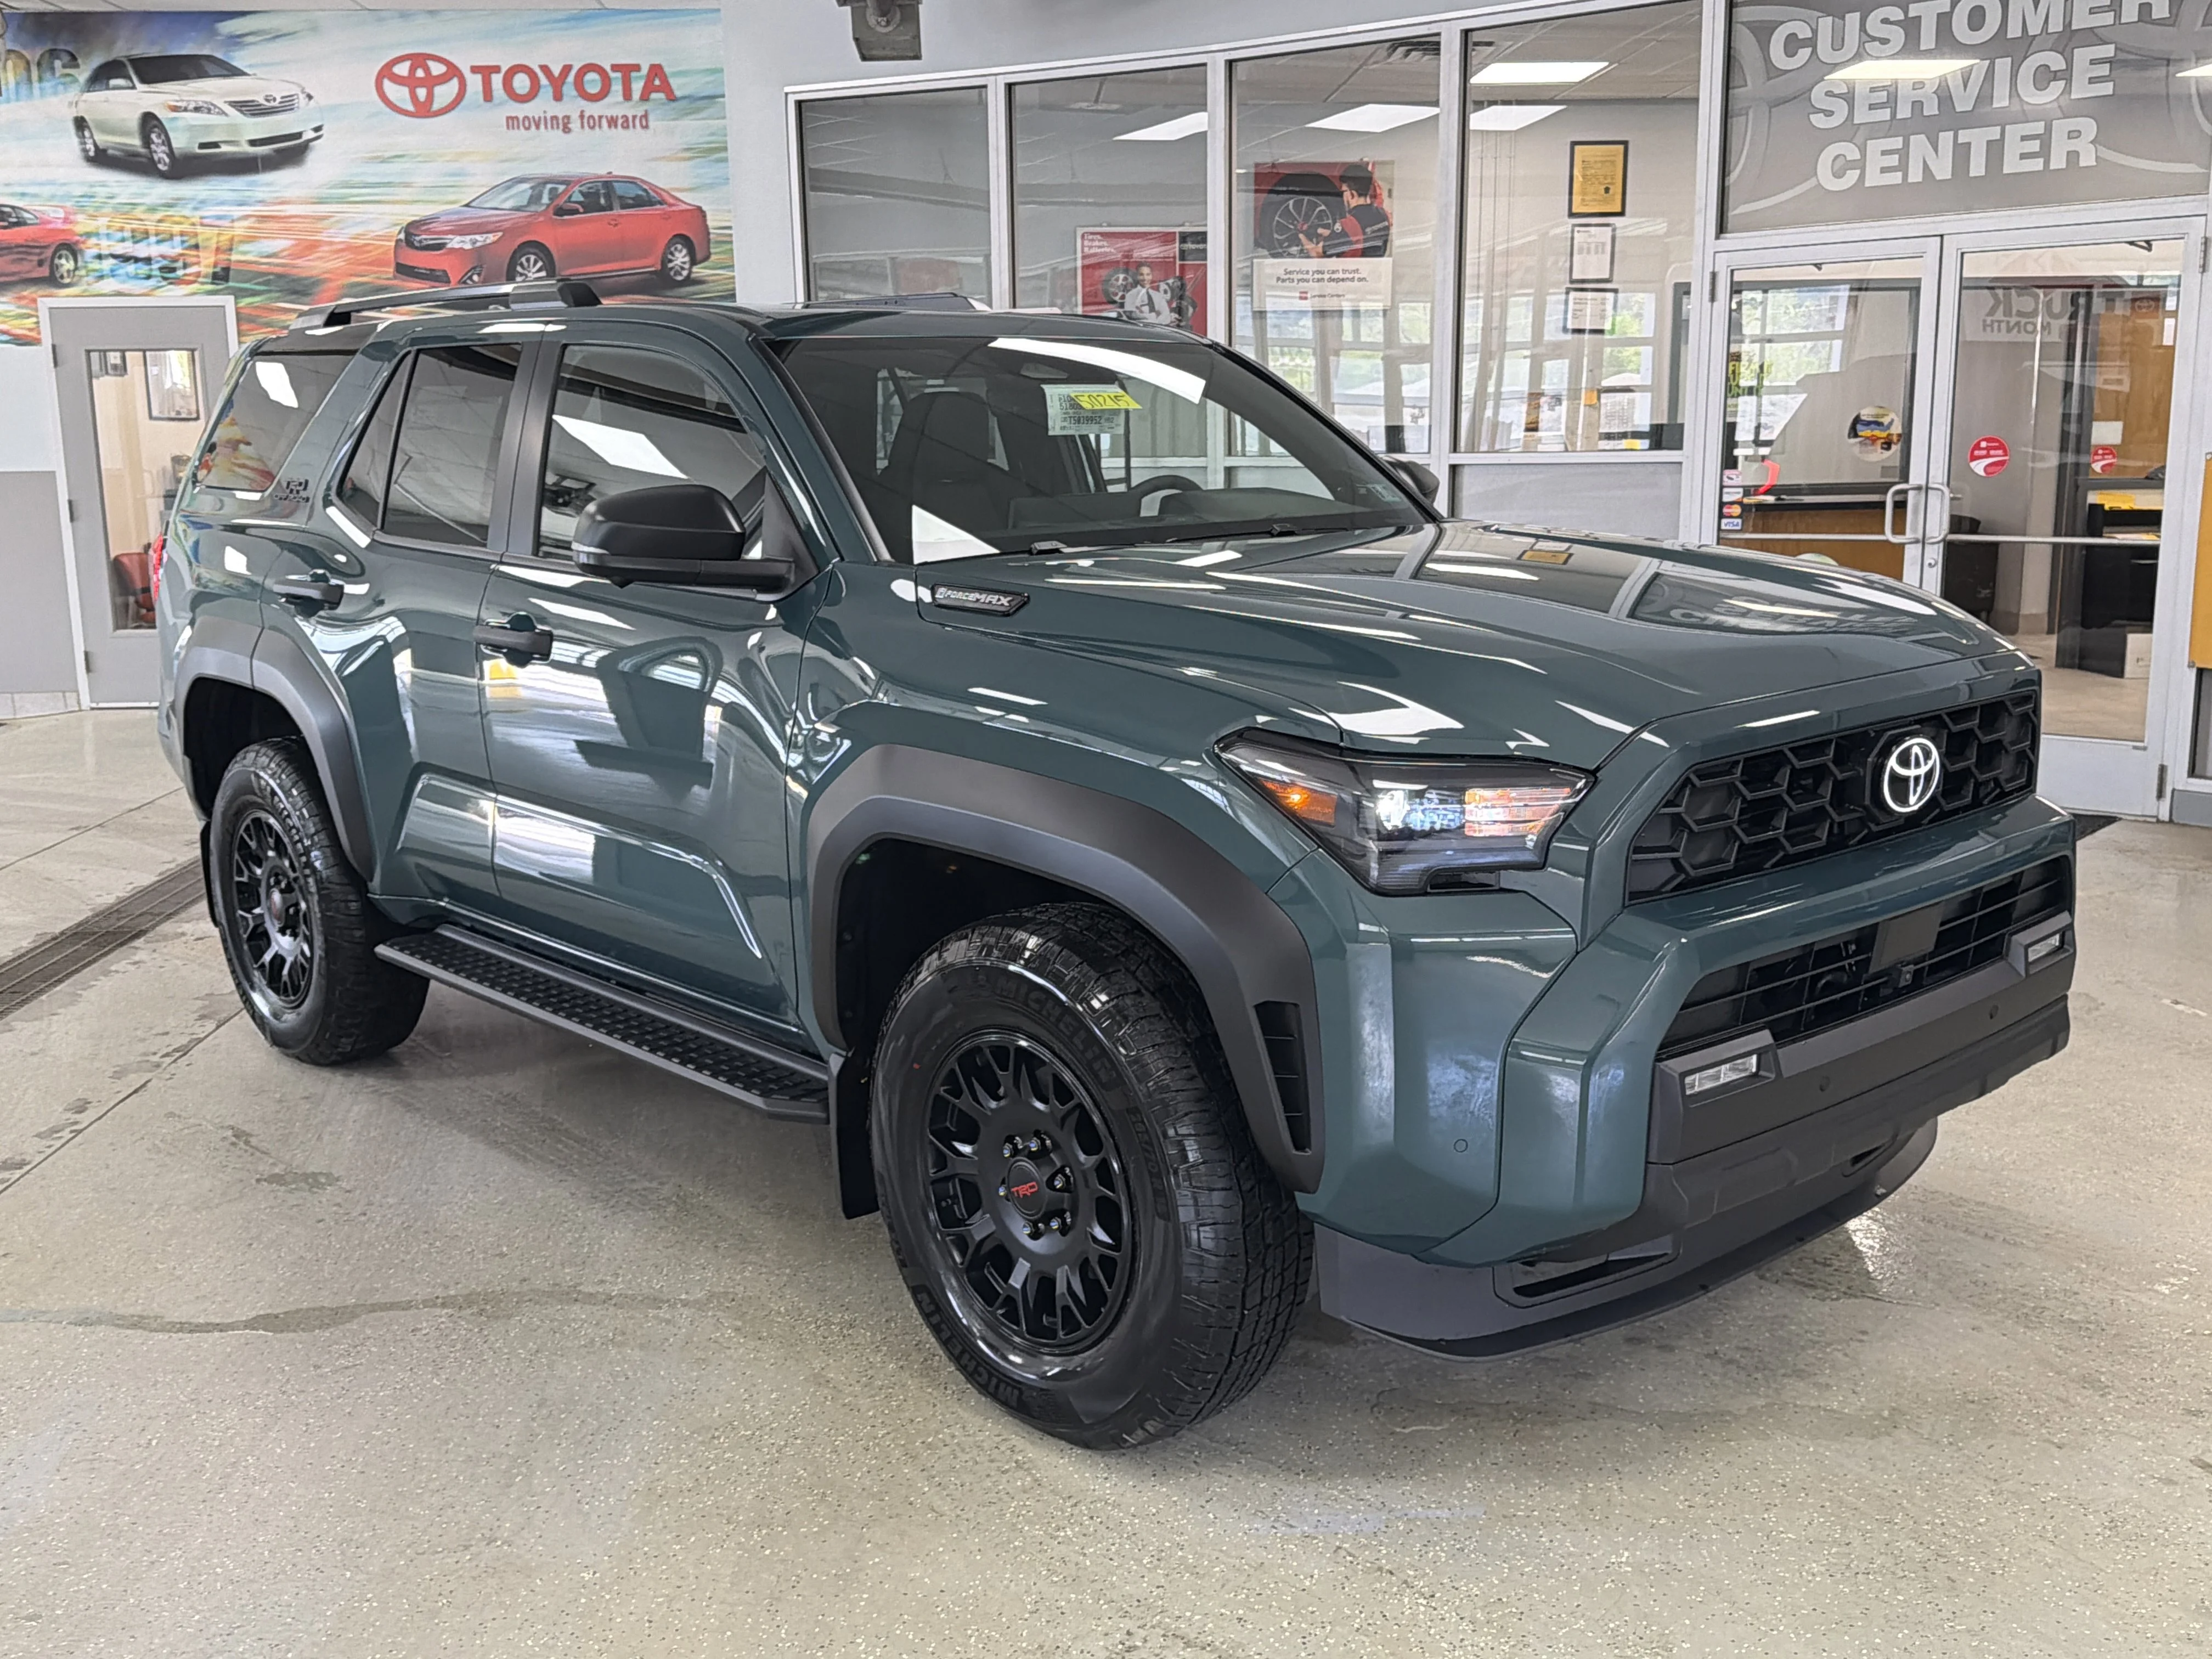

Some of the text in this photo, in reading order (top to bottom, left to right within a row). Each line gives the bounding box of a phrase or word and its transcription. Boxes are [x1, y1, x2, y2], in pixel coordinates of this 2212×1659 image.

[470, 63, 676, 104] TOYOTA
[1808, 43, 2116, 129] SERVICE
[506, 109, 650, 134] moving forward
[1816, 116, 2099, 192] CENTER
[1283, 268, 1310, 276] Service
[1327, 276, 1356, 284] depend
[1011, 1181, 1039, 1198] TRD
[916, 1291, 1022, 1405] MICHELIN
